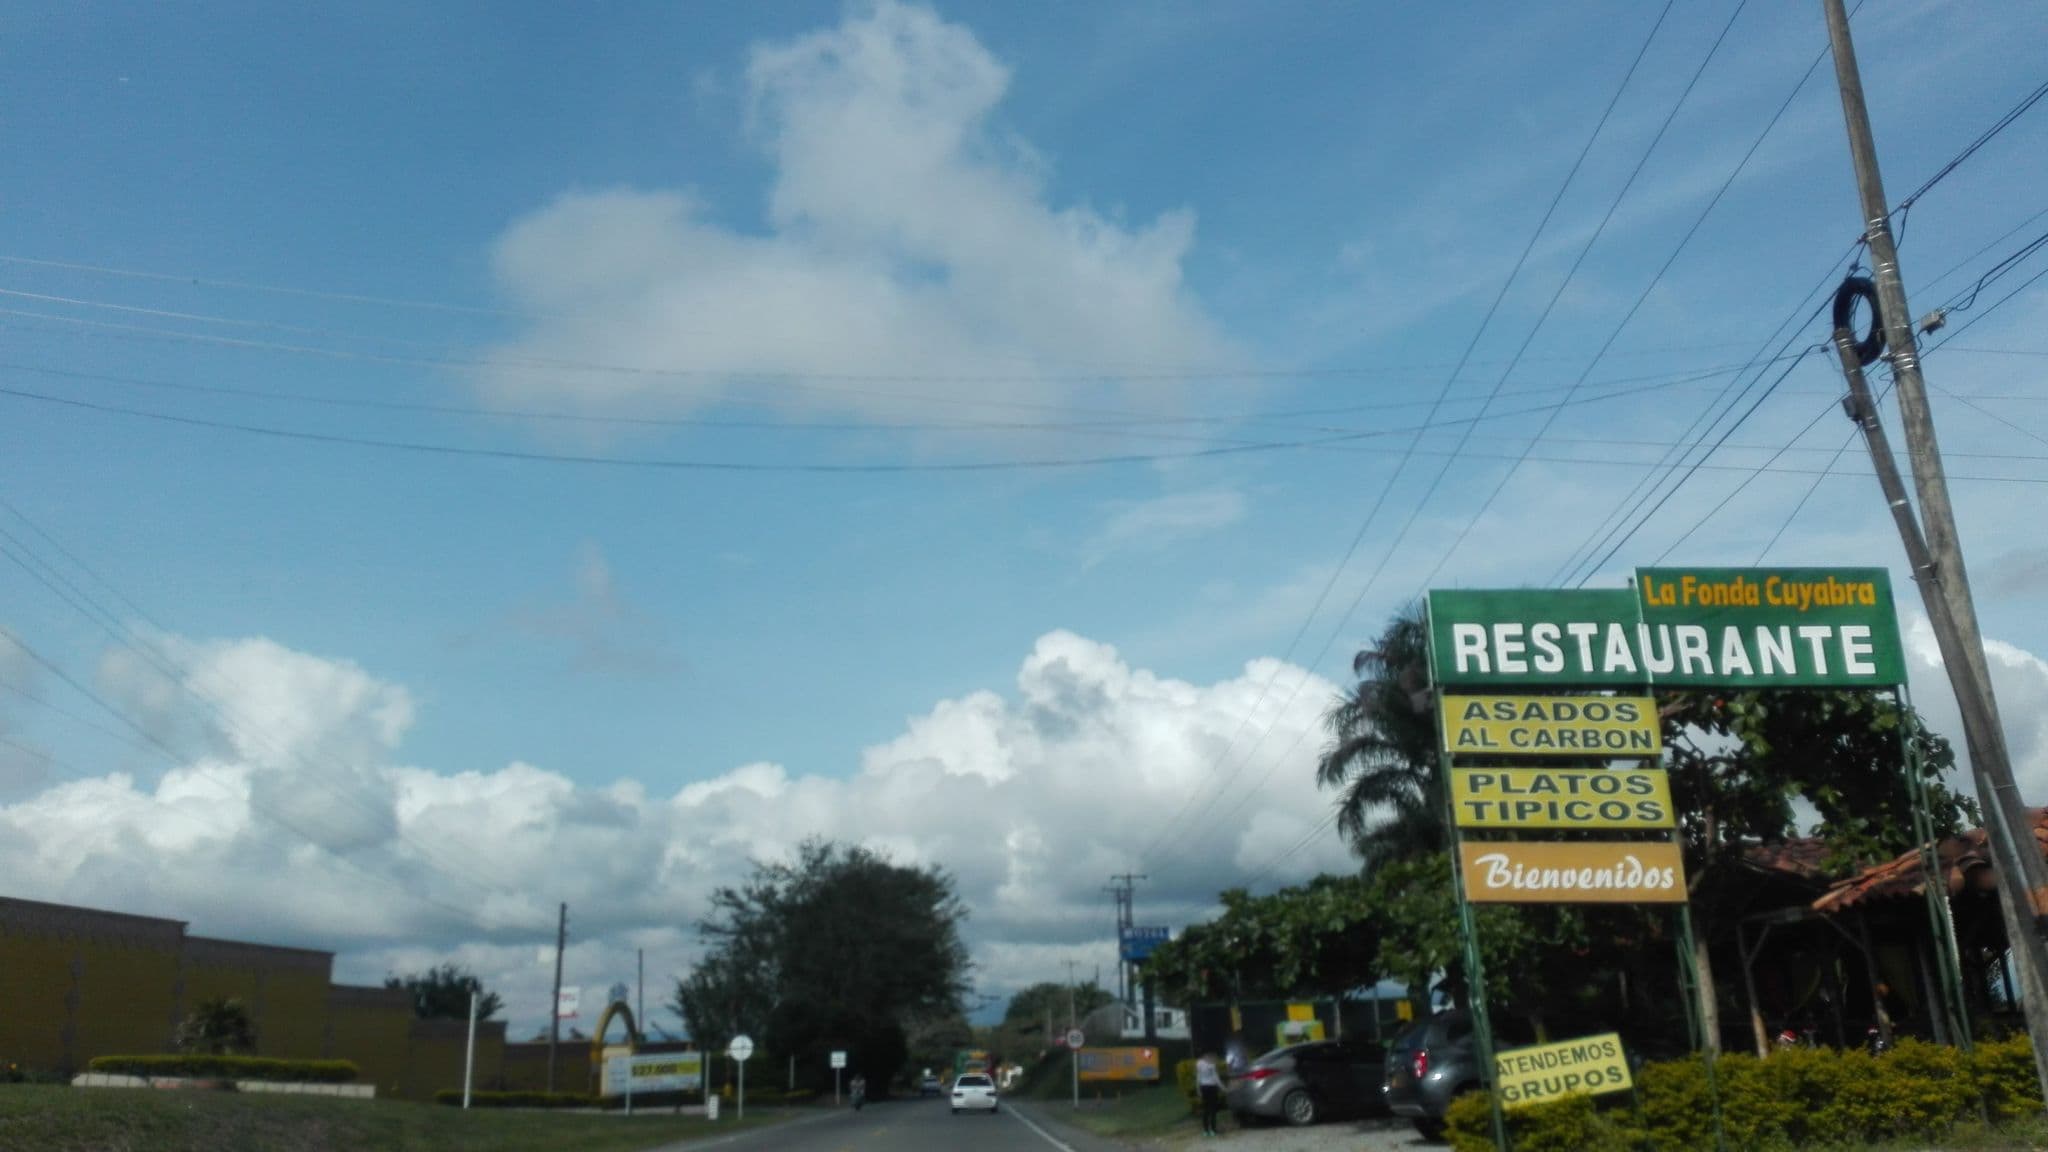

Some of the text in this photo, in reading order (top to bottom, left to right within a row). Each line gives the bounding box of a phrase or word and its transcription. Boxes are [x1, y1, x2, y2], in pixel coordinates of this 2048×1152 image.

[1644, 575, 1875, 611] La Fonda Cuyabra
[1453, 622, 1876, 676] RESTAURANTE
[1463, 701, 1639, 722] ASADOS
[1457, 728, 1653, 749] AL CARBON
[1468, 773, 1655, 795] PLATOS
[1464, 799, 1665, 822] TIPICOS
[1474, 852, 1675, 890] Bienvenidos
[1496, 1041, 1616, 1076] ATENDEMOS
[1502, 1065, 1623, 1102] GRUPOS
